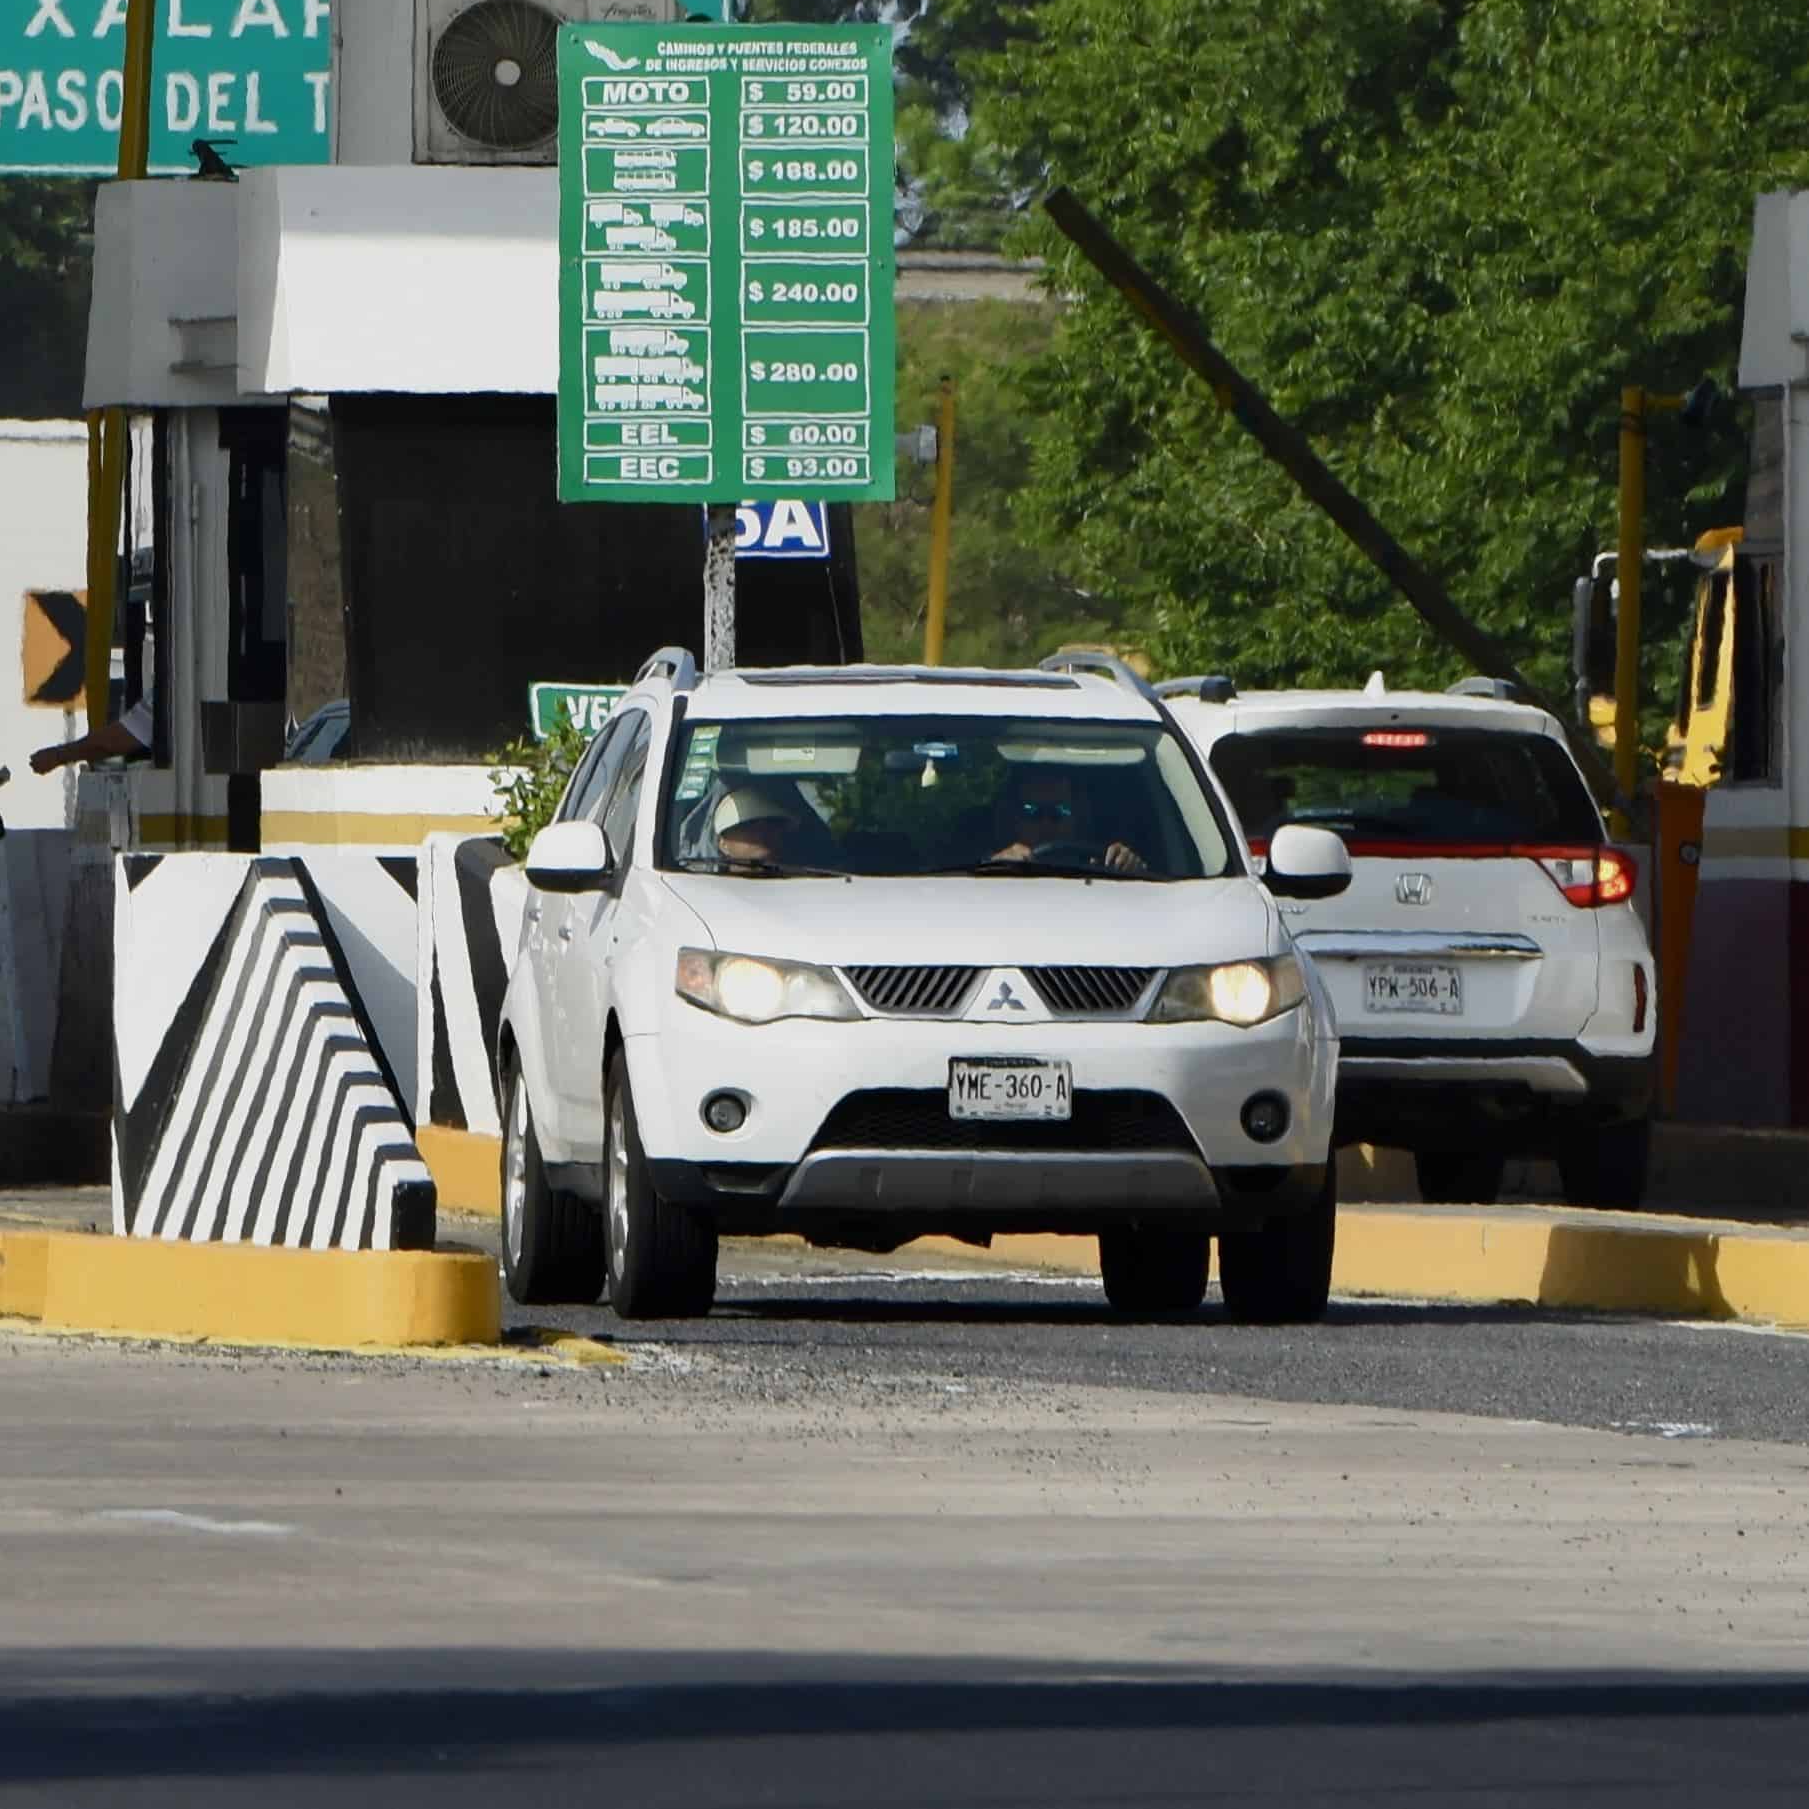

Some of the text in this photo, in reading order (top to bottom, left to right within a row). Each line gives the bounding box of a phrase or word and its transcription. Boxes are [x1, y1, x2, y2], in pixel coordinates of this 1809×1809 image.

[657, 41, 858, 56] CAMINOS Y PUENTES FEDERALES
[646, 58, 663, 72] DE
[665, 58, 728, 72] INGRESOS
[742, 58, 806, 72] SERVICIOS
[809, 58, 868, 72] CONEXOS
[166, 70, 278, 134] DEL
[602, 82, 690, 105] MOTO
[749, 82, 857, 103] $ 59.00
[748, 115, 858, 136] $ 120.00
[748, 160, 764, 182] $
[750, 218, 860, 240] $ 185.00
[749, 281, 858, 303] $ 240.00
[750, 362, 766, 382] $
[621, 423, 679, 445] EEL
[750, 425, 857, 445] $ 60.00
[619, 458, 681, 480] EEC
[750, 457, 858, 479] $ 93.00
[956, 1073, 1067, 1100] YME-360-A
